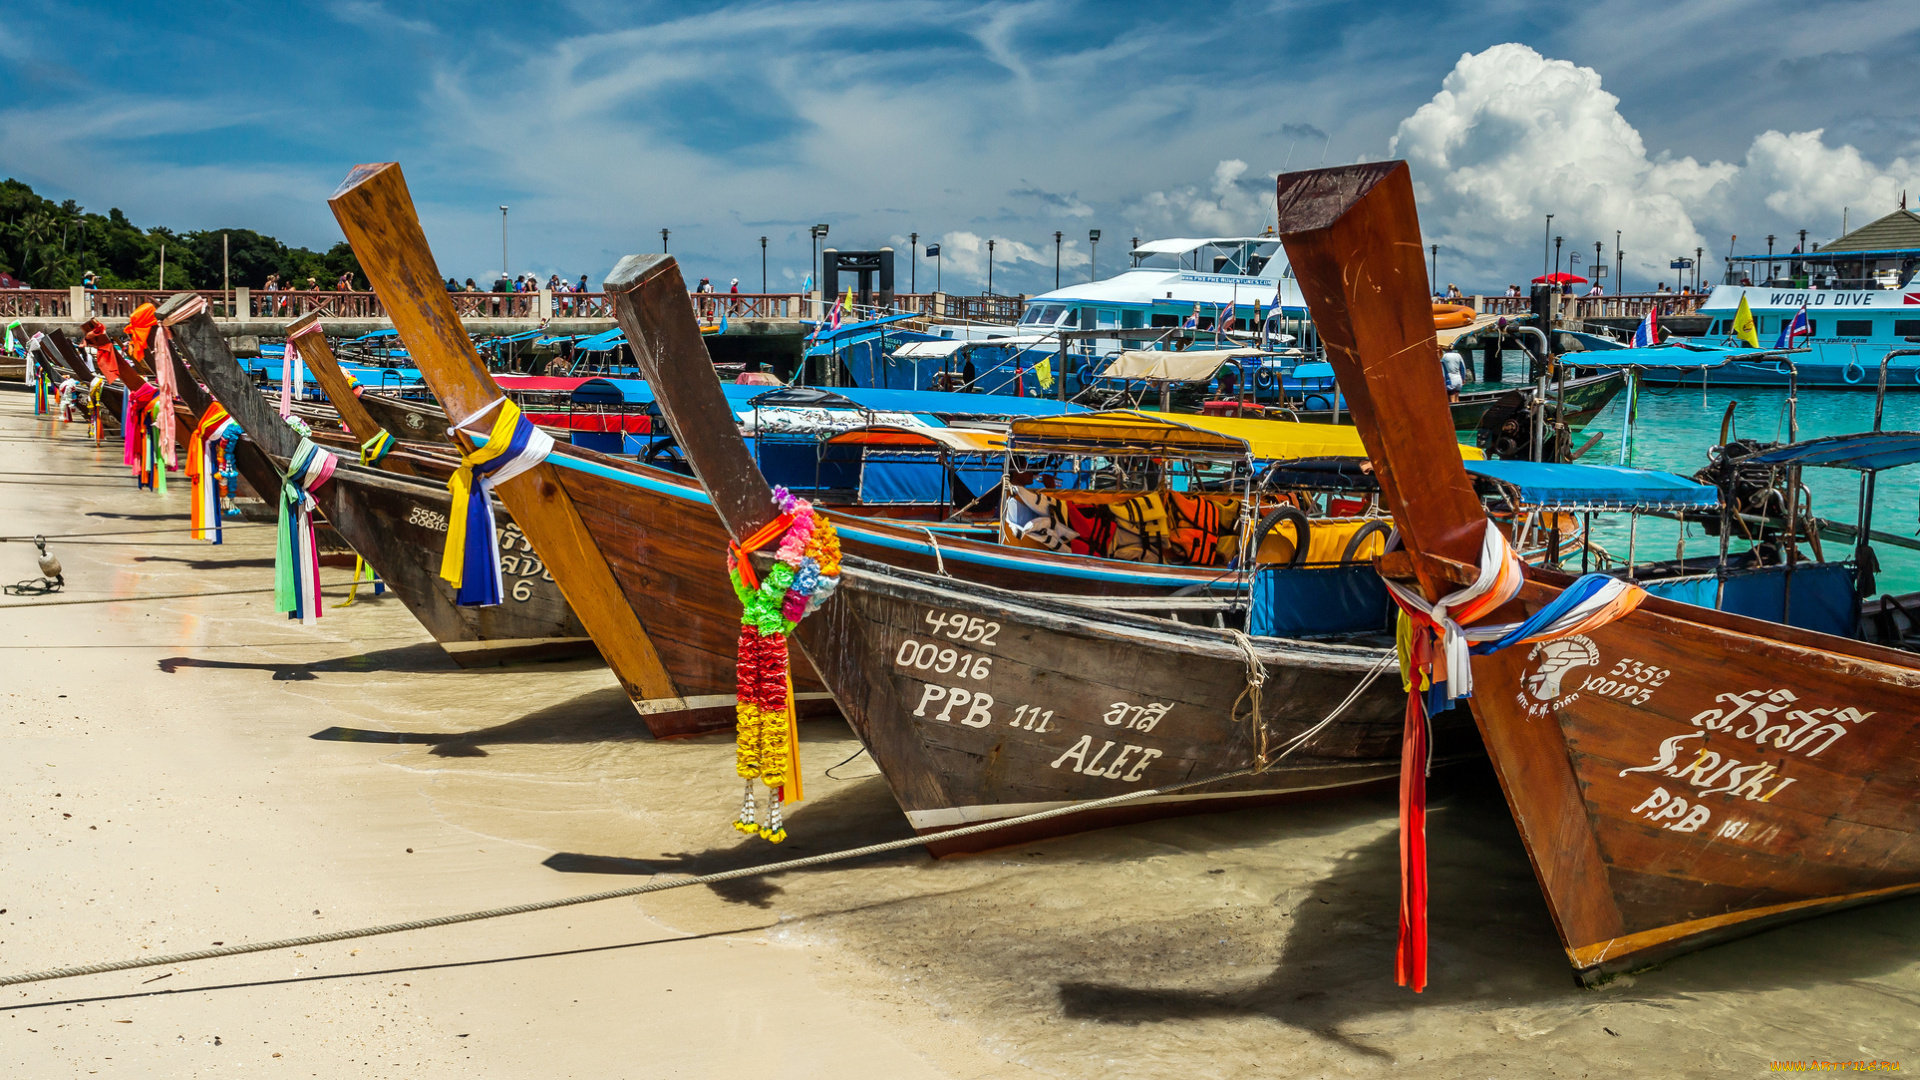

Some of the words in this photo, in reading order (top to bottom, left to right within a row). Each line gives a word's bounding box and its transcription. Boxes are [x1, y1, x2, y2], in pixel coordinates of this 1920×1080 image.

[1770, 293, 1825, 305] WORLD
[1834, 293, 1875, 305] DIVE
[512, 580, 534, 601] 6
[925, 609, 1000, 646] 4952
[896, 640, 993, 680] 00916
[1612, 658, 1671, 687] 5352
[913, 683, 994, 728] PPB
[1009, 704, 1055, 733] 111
[1051, 735, 1163, 782] ALEE
[1717, 820, 1750, 839] 161
